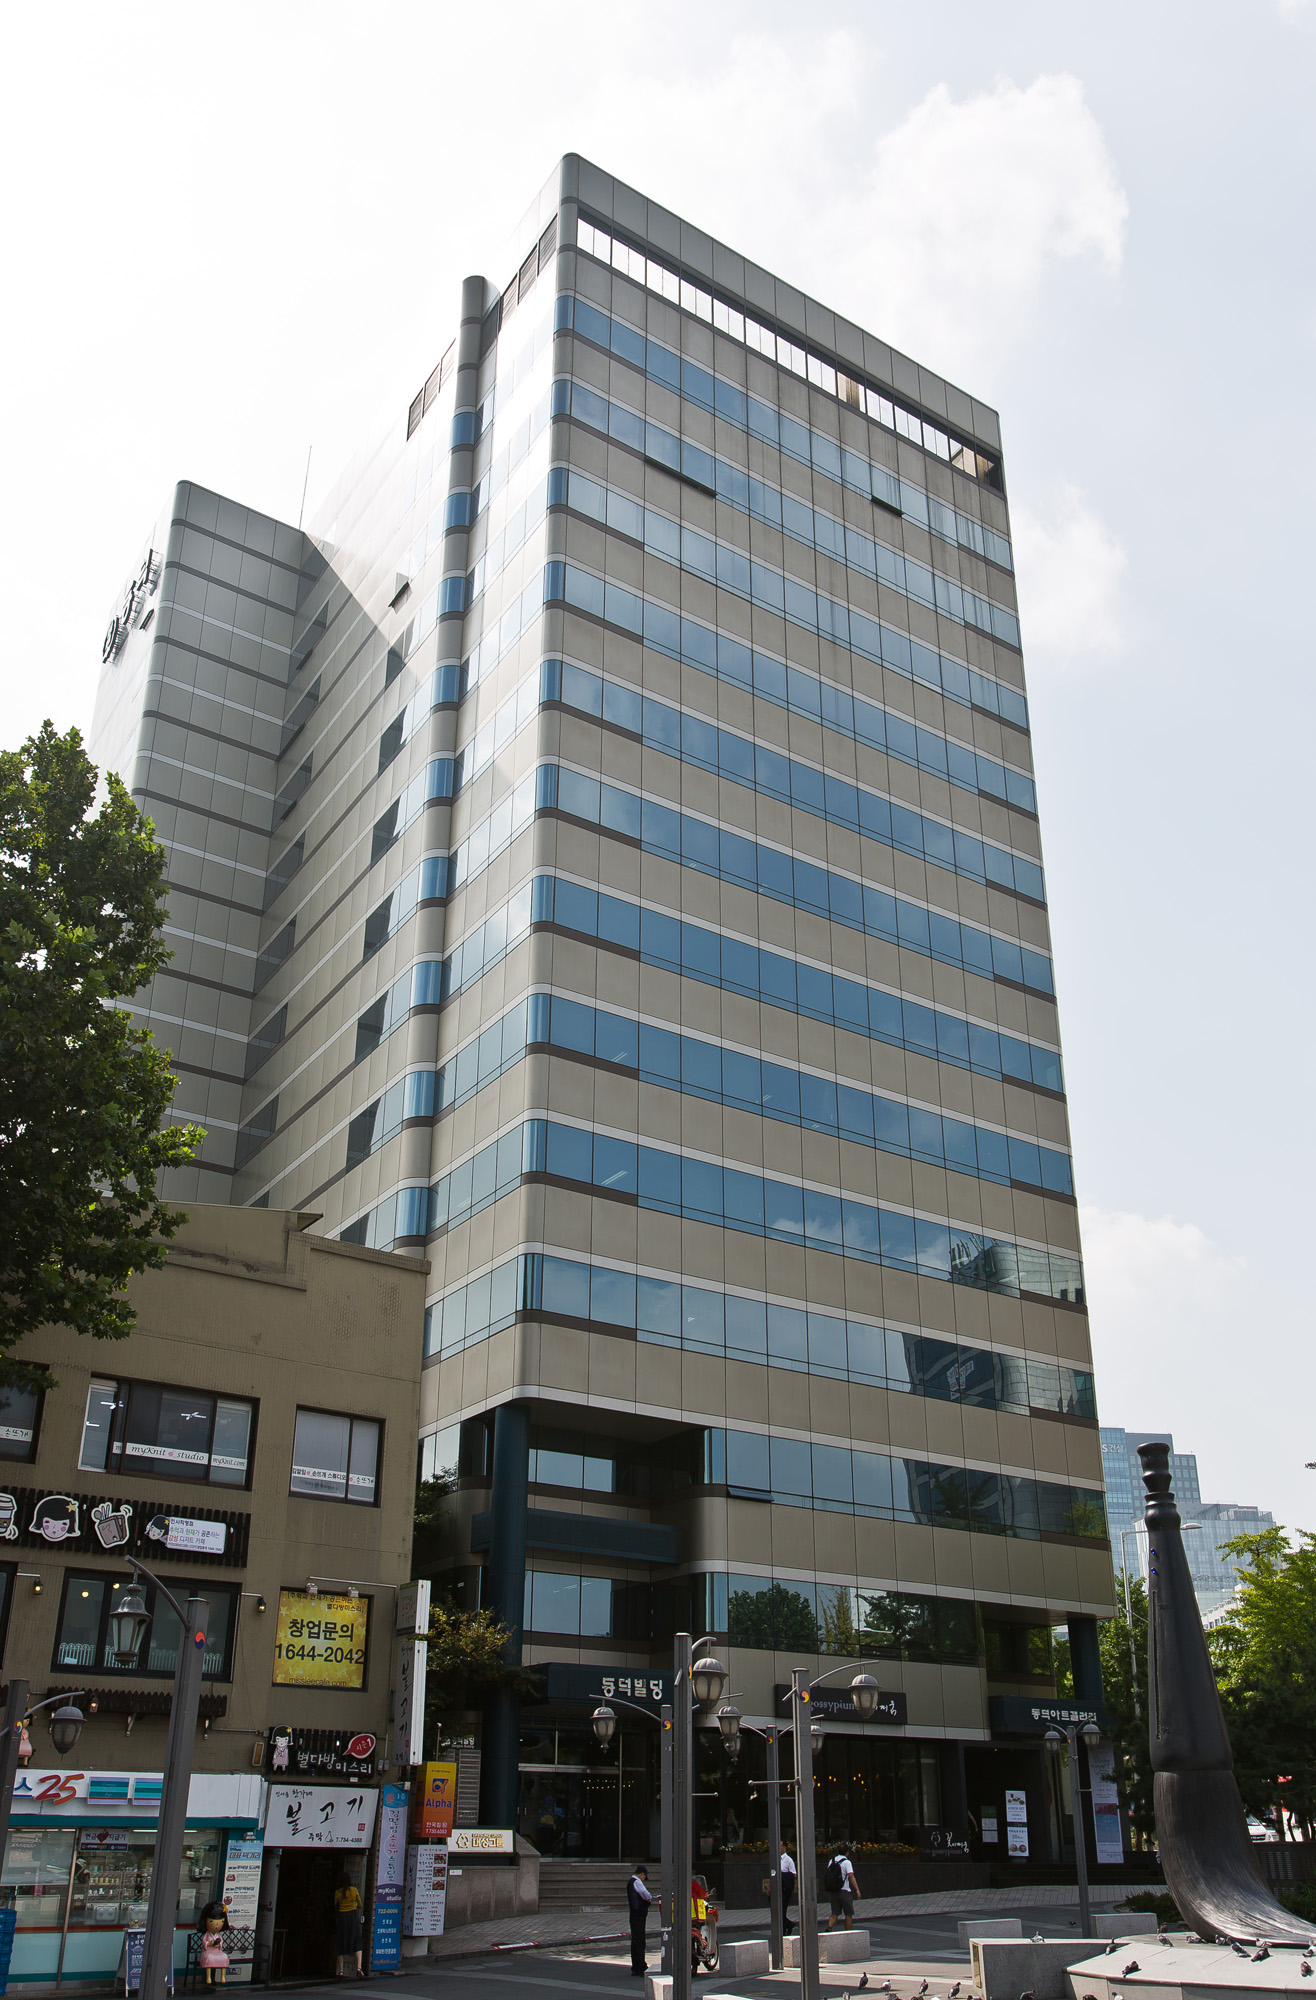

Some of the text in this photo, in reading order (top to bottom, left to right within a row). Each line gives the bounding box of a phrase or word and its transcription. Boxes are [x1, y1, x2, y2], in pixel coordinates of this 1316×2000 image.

[131, 1445, 166, 1457] myKnit
[176, 1451, 205, 1461] studio
[288, 1618, 354, 1642] 창업문의
[275, 1643, 364, 1665] 1644-2042
[601, 1677, 663, 1700] 동덕빌딩
[1031, 1708, 1097, 1722] 동덕아트갤러리
[425, 1798, 452, 1809] Alpha
[286, 1795, 364, 1836] 불고기
[308, 1832, 323, 1842] 주막
[377, 1887, 396, 1895] myKnit
